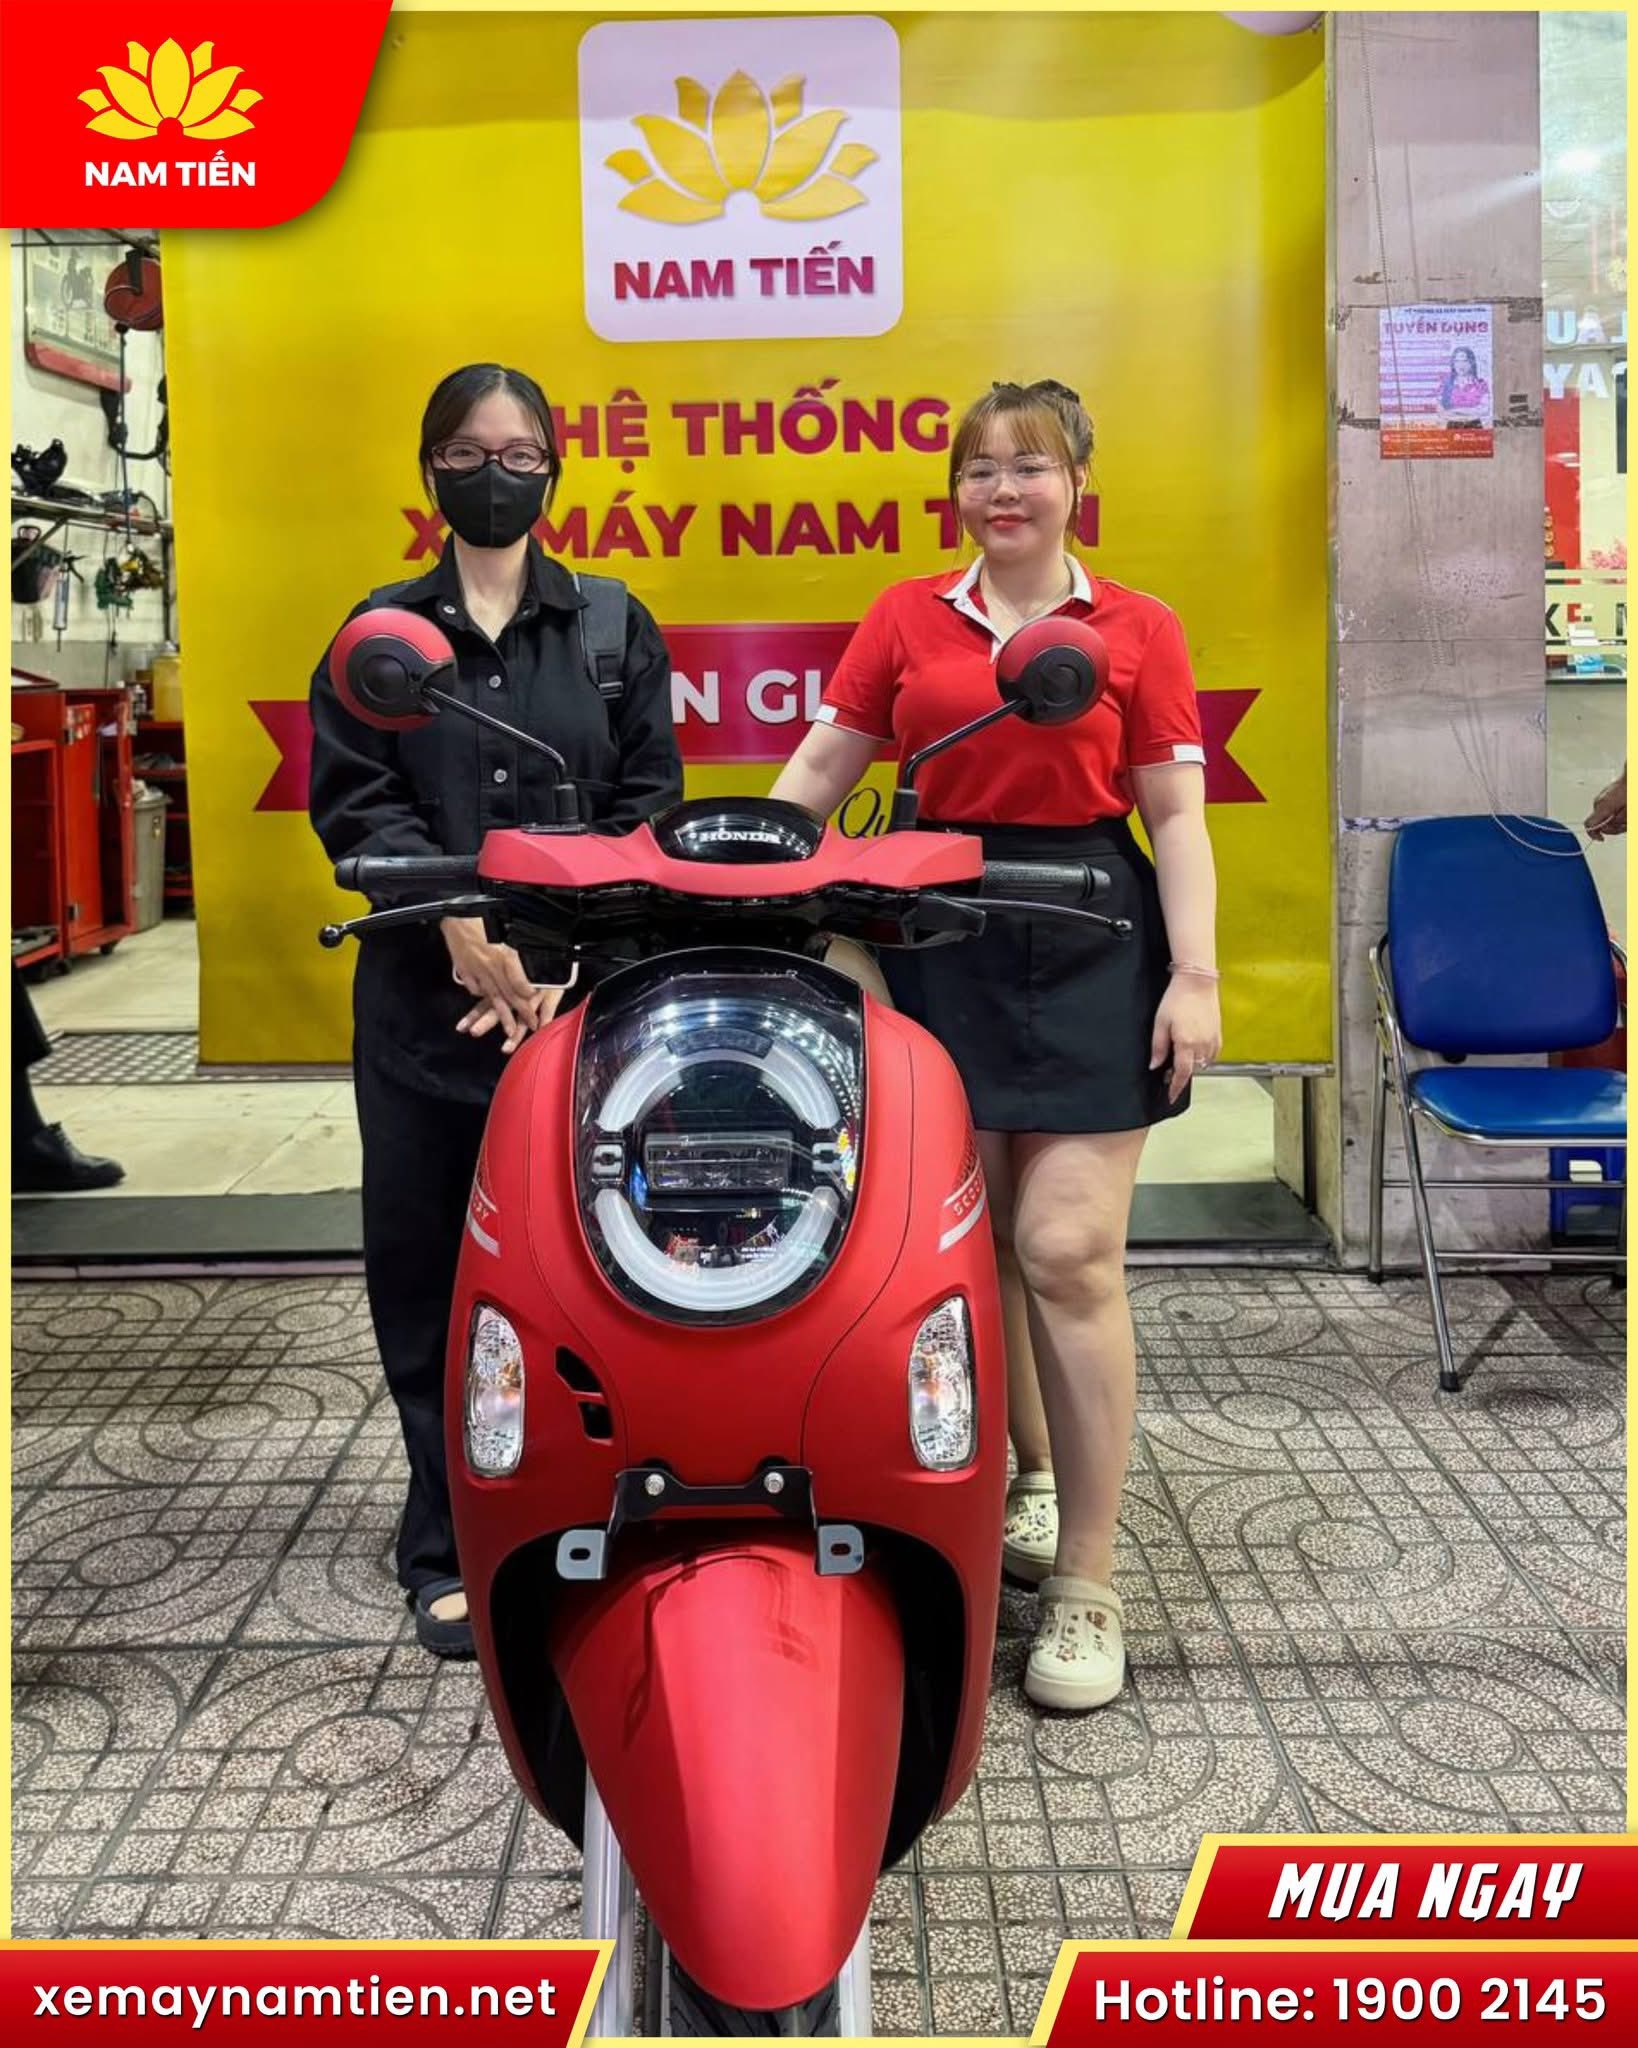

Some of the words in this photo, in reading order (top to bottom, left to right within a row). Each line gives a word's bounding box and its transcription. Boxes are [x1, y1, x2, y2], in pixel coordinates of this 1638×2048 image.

[613, 259, 735, 300] NAM
[749, 240, 875, 296] TIẾN
[551, 386, 650, 474] HỆ
[672, 378, 951, 456] THỐNG
[531, 489, 698, 559] MÁY
[721, 501, 900, 557] NAM
[699, 830, 782, 845] HONDA
